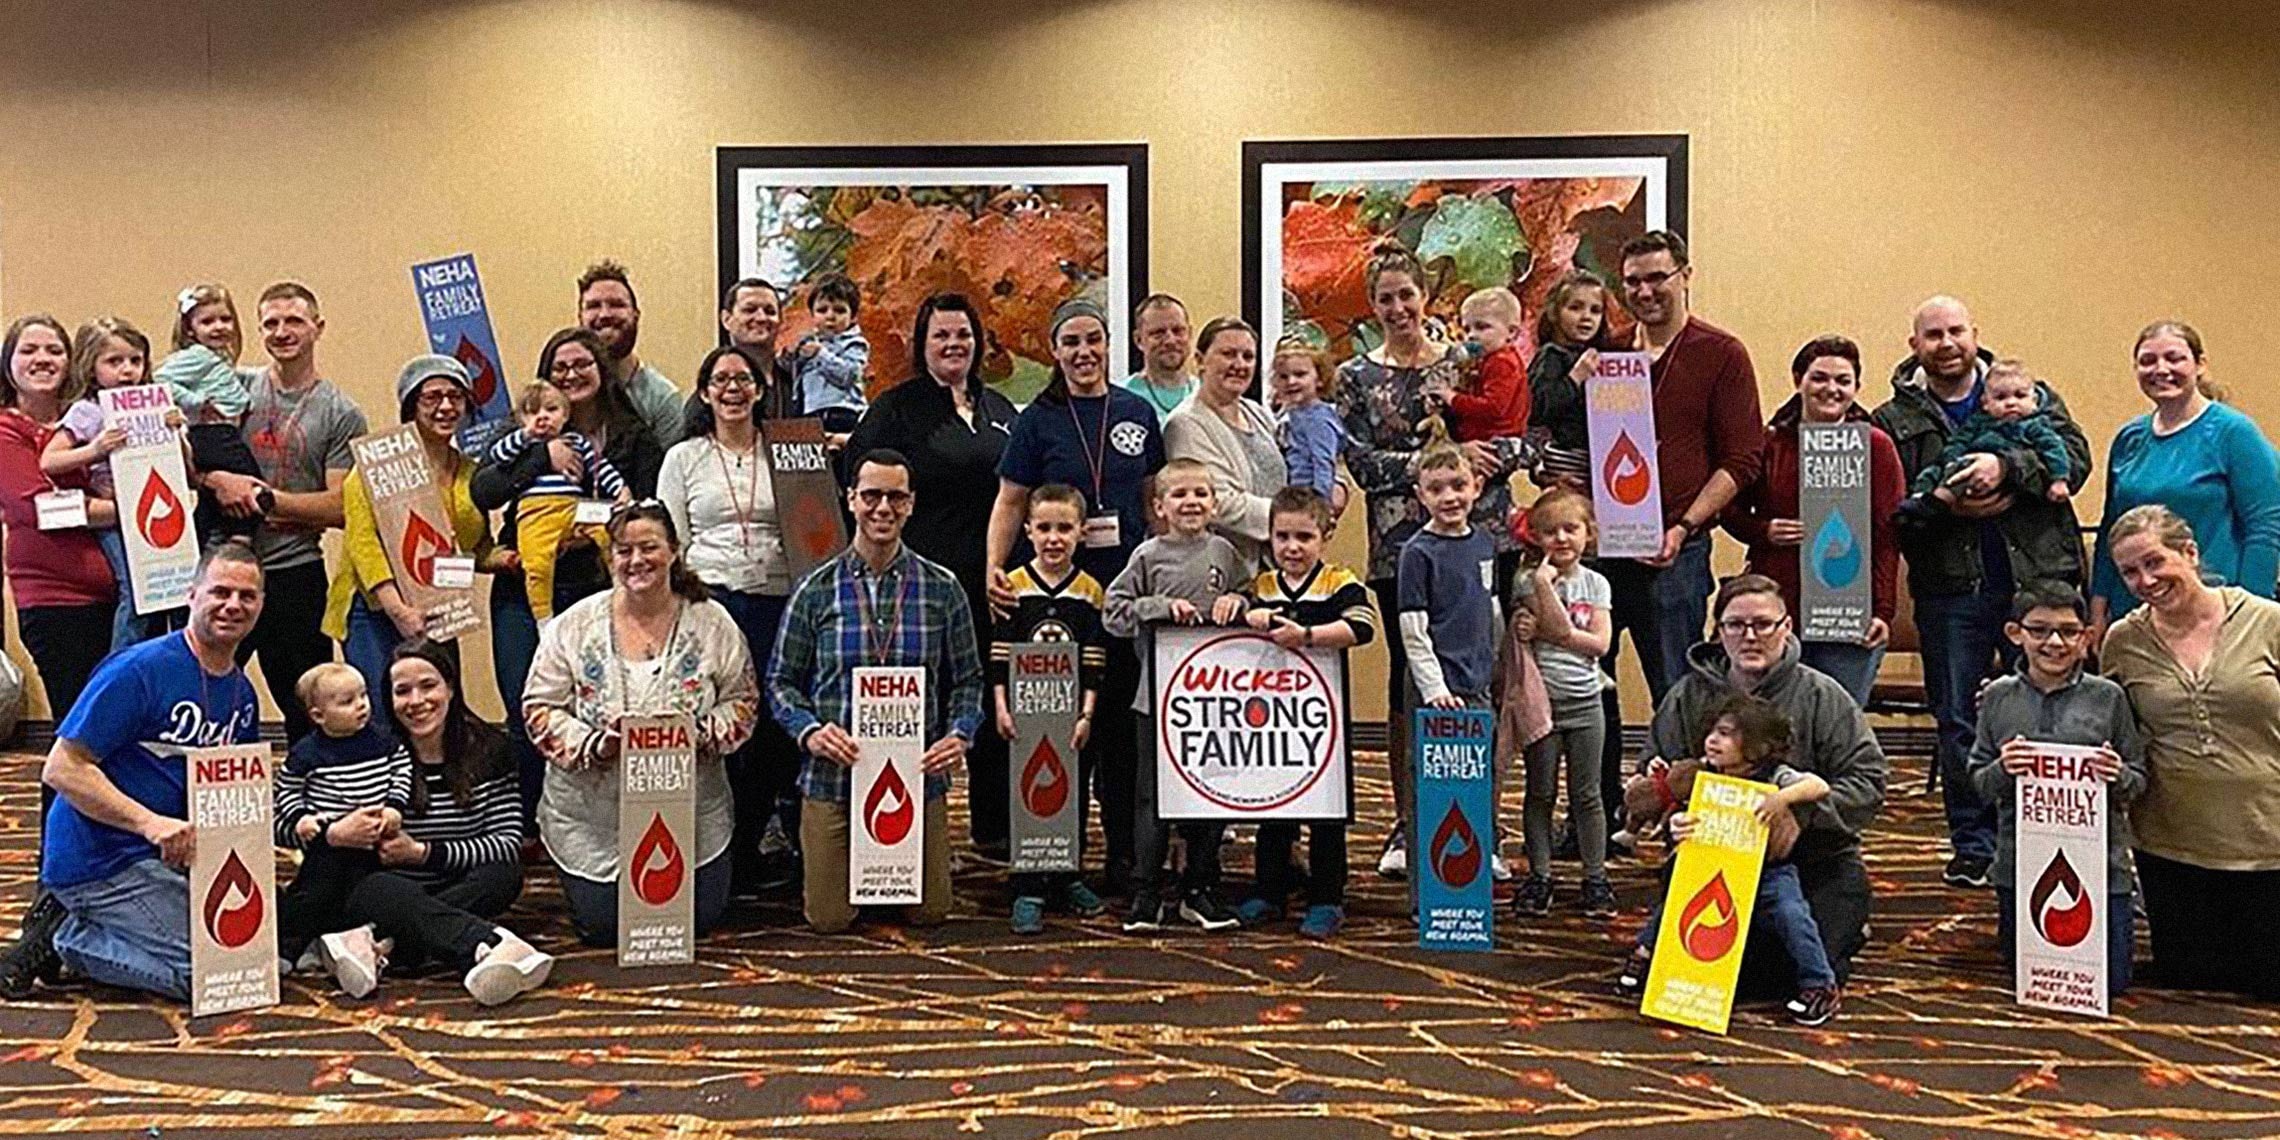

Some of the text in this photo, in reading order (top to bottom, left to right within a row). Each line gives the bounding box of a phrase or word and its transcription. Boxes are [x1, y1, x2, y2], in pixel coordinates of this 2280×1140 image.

[419, 260, 475, 289] NEHA
[424, 283, 480, 310] FAMILY
[428, 299, 482, 320] RETREAT
[111, 386, 170, 411] NEHA
[115, 415, 165, 433] FAMIL
[358, 431, 419, 466] NEHA
[1805, 430, 1864, 451] NEHA
[771, 443, 824, 461] FAMILY
[366, 454, 424, 485] FAMILY
[1805, 456, 1865, 474] FAMILY
[373, 469, 430, 500] RETREAT
[1804, 472, 1864, 488] RETREAT
[1016, 653, 1073, 675] NEHA
[860, 675, 920, 698] NEHA
[1016, 680, 1074, 699] FAMILY
[1183, 665, 1312, 692] WICKED
[860, 704, 921, 722] FAMILY
[1015, 698, 1073, 714] RETREAT
[1170, 696, 1328, 728] STRONG
[628, 725, 690, 749] NEHA
[858, 722, 919, 738] RETREAT
[1424, 716, 1487, 738] NEHA
[1181, 730, 1324, 767] FAMILY
[1423, 744, 1486, 764] FAMILY
[195, 756, 265, 784] NEHA
[627, 754, 690, 775] FAMILY
[1423, 761, 1487, 779] RETREAT
[626, 773, 690, 792] RETREAT
[196, 786, 266, 810] FAMILY
[2022, 784, 2097, 810] FAMILY
[197, 804, 267, 828] RETREAT
[1699, 811, 1753, 839] FAMIL
[2022, 805, 2098, 827] RETREAT
